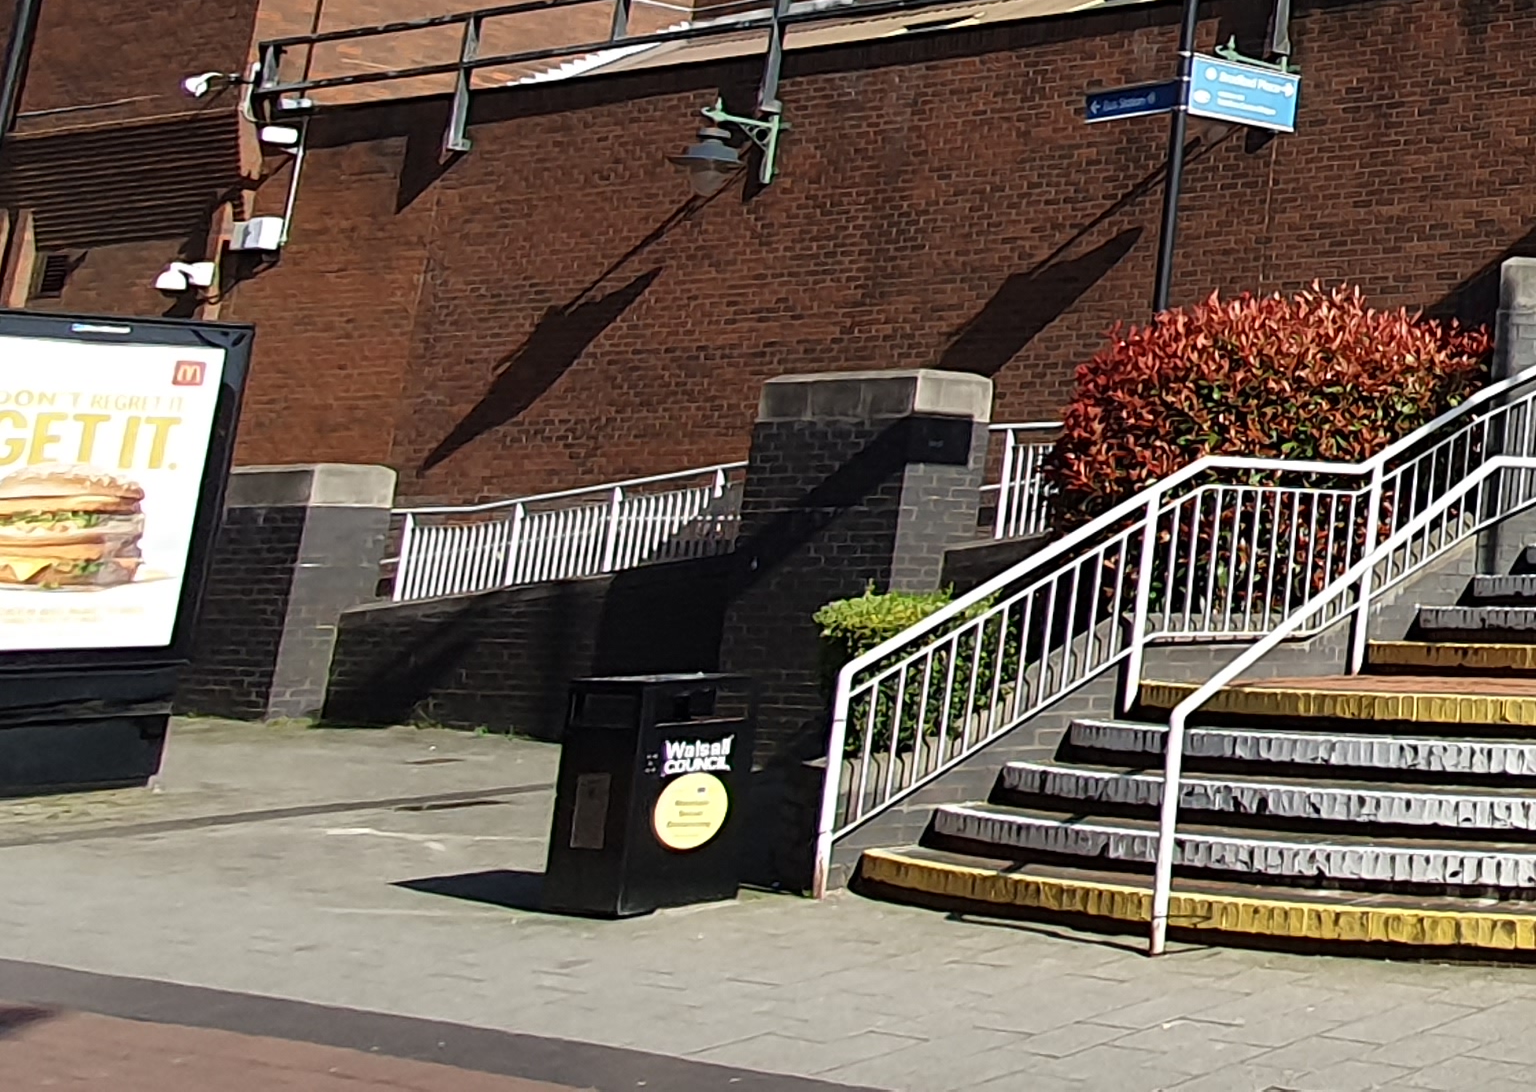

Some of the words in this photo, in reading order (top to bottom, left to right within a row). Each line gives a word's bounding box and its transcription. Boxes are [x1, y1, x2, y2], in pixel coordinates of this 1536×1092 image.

[0, 409, 112, 466] GET
[665, 735, 732, 759] Walsall
[663, 755, 731, 774] COUNCIL
